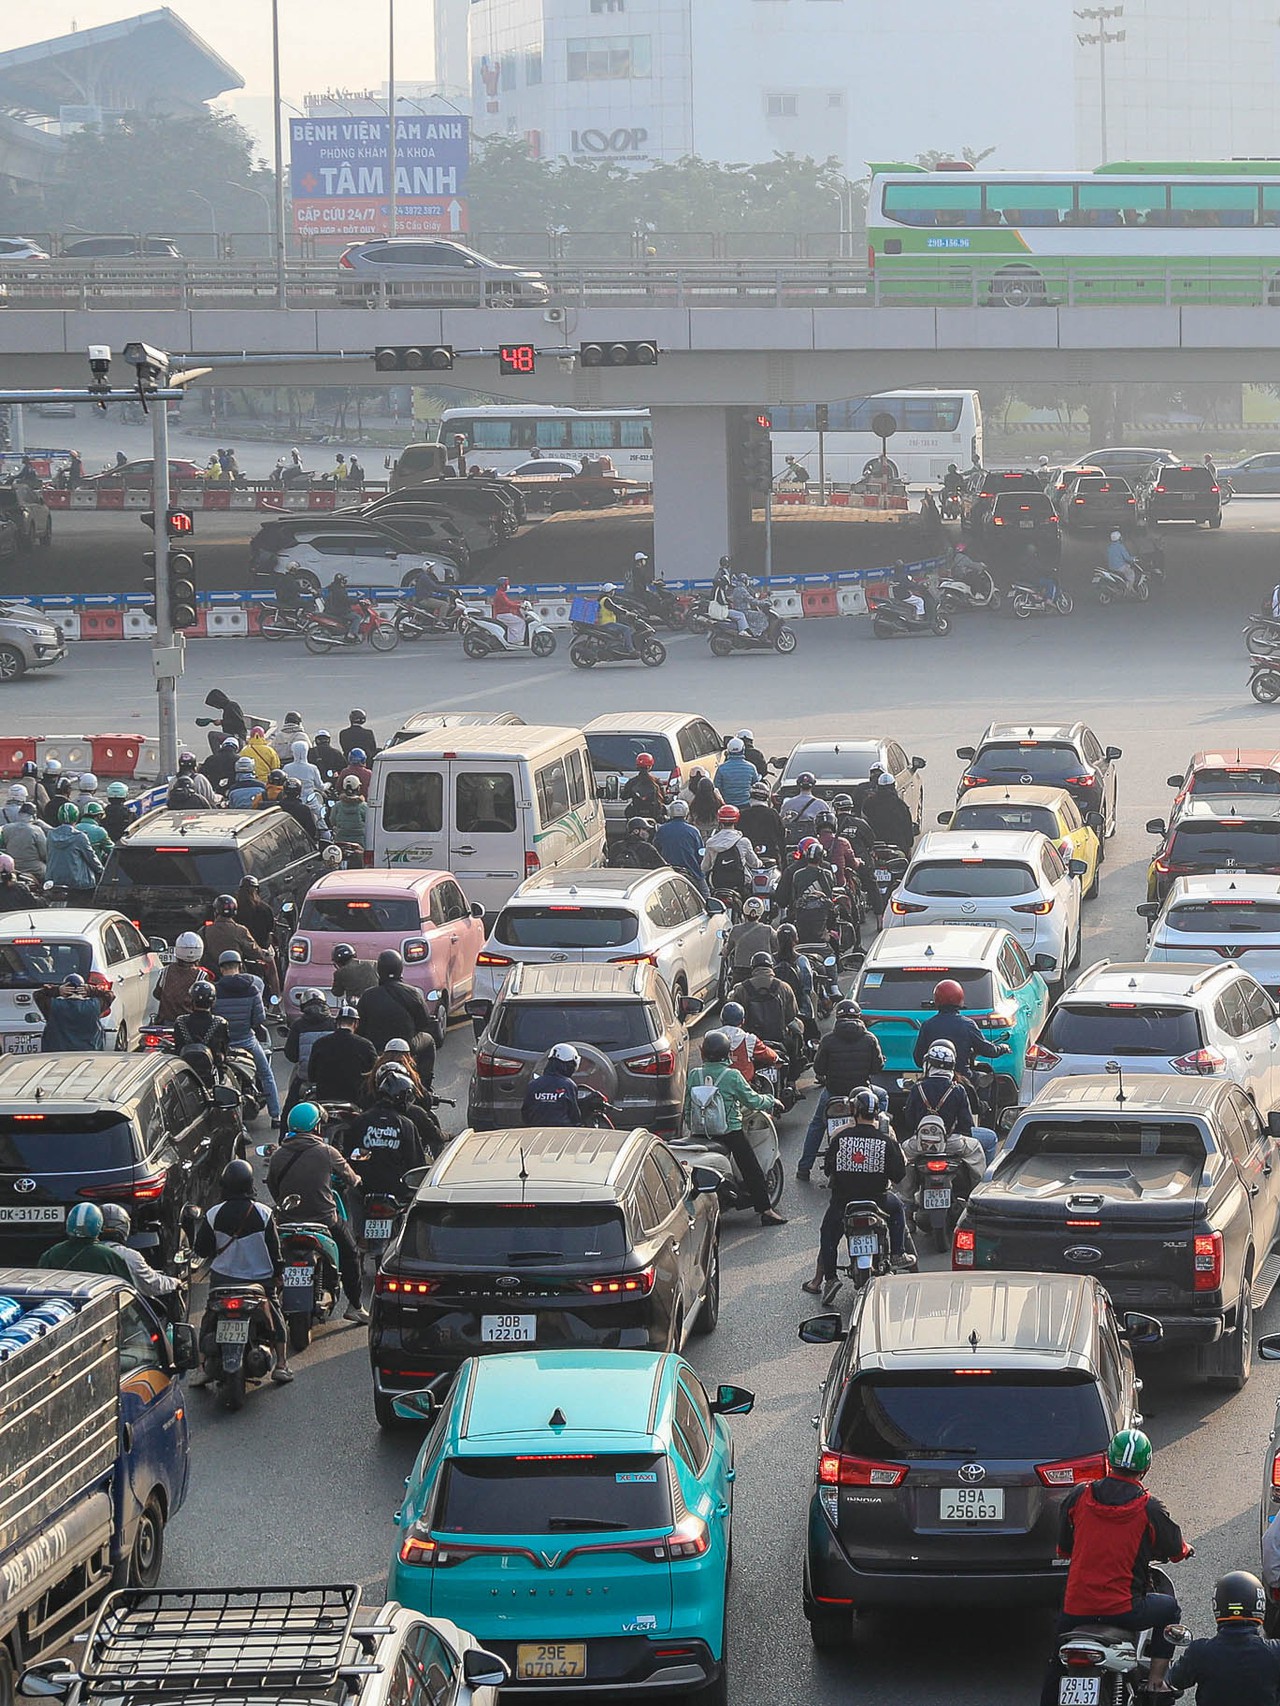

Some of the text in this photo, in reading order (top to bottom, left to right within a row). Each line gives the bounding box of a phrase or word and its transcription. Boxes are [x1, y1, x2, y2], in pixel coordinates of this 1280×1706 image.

[294, 121, 462, 146] BỆNH VIỆN ÂM ANH
[571, 128, 648, 153] LOOP
[407, 148, 435, 158] KHOA
[320, 161, 457, 195] TÂM ANH
[347, 208, 376, 221] 24/7
[502, 346, 534, 372] 48
[535, 1092, 558, 1101] USTH
[496, 1315, 520, 1328] 30B
[488, 1328, 528, 1341] 122.01
[958, 1490, 985, 1503] 89A
[951, 1504, 997, 1519] 256.63
[622, 1623, 658, 1631] VFe34
[537, 1646, 566, 1660] 29E
[525, 1660, 578, 1677] 070.47
[1064, 1679, 1094, 1692] 29-L5
[1061, 1691, 1097, 1705] 274.37
